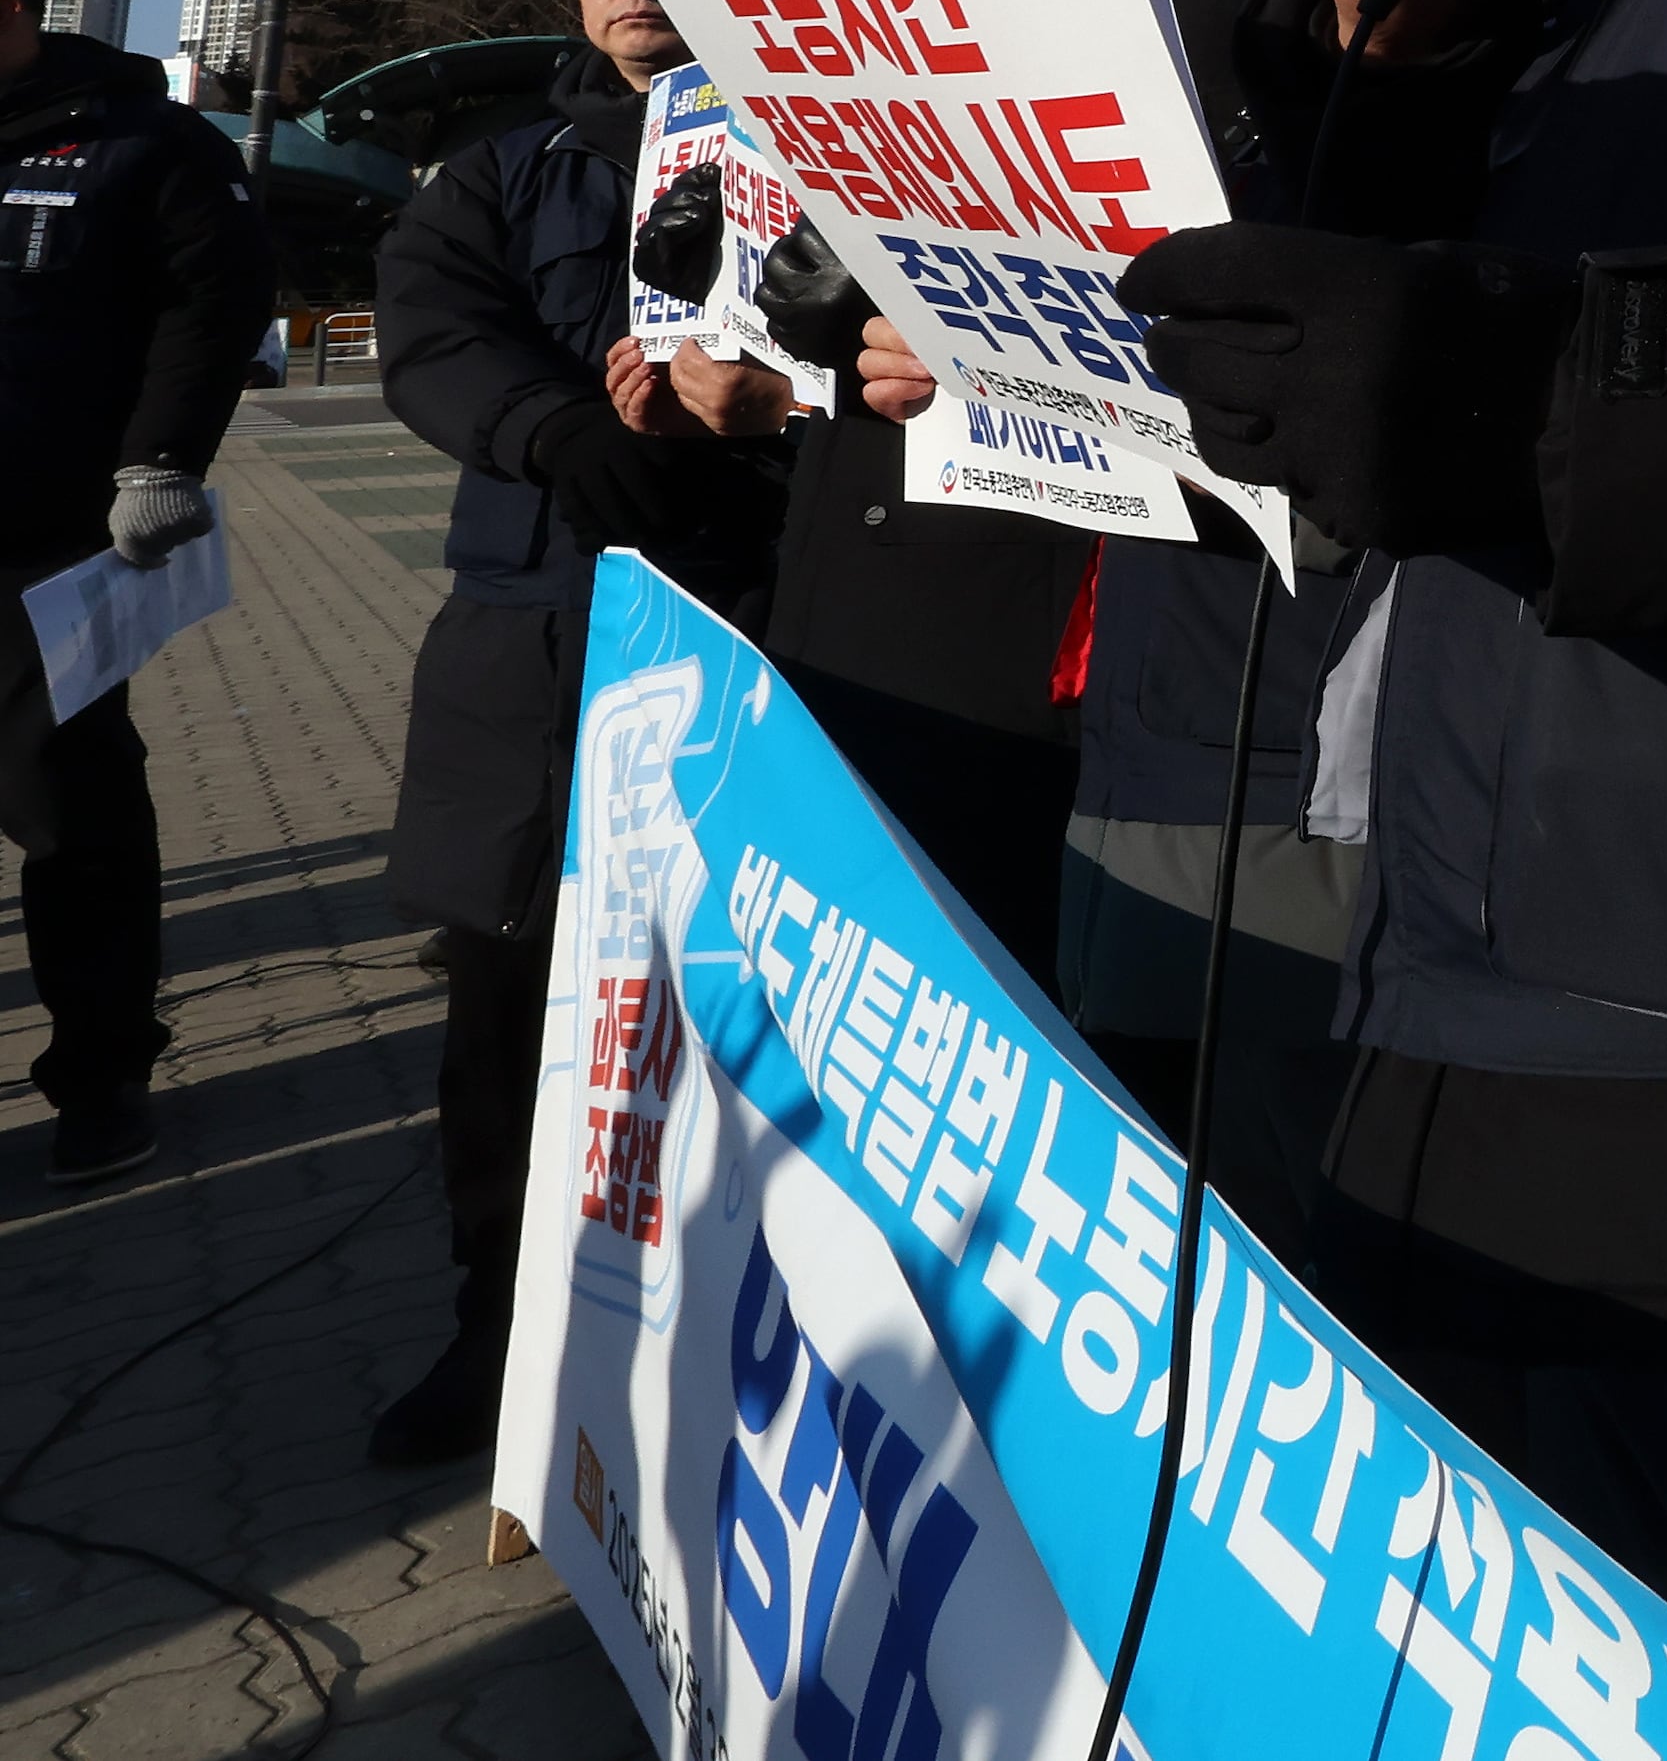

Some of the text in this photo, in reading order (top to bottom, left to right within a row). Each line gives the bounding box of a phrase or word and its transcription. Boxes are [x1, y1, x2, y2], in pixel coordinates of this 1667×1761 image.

[742, 91, 1170, 258] 적용제외 시도
[876, 234, 1062, 366] 즉각
[976, 367, 1107, 428] 한국노동조합총연맹
[962, 466, 1150, 519] 한국노동조합총연맹 전국민주노동조합총연맹
[588, 977, 682, 1102] 과로사
[581, 1106, 663, 1248] 조장법
[981, 1078, 1376, 1636] 노동시간
